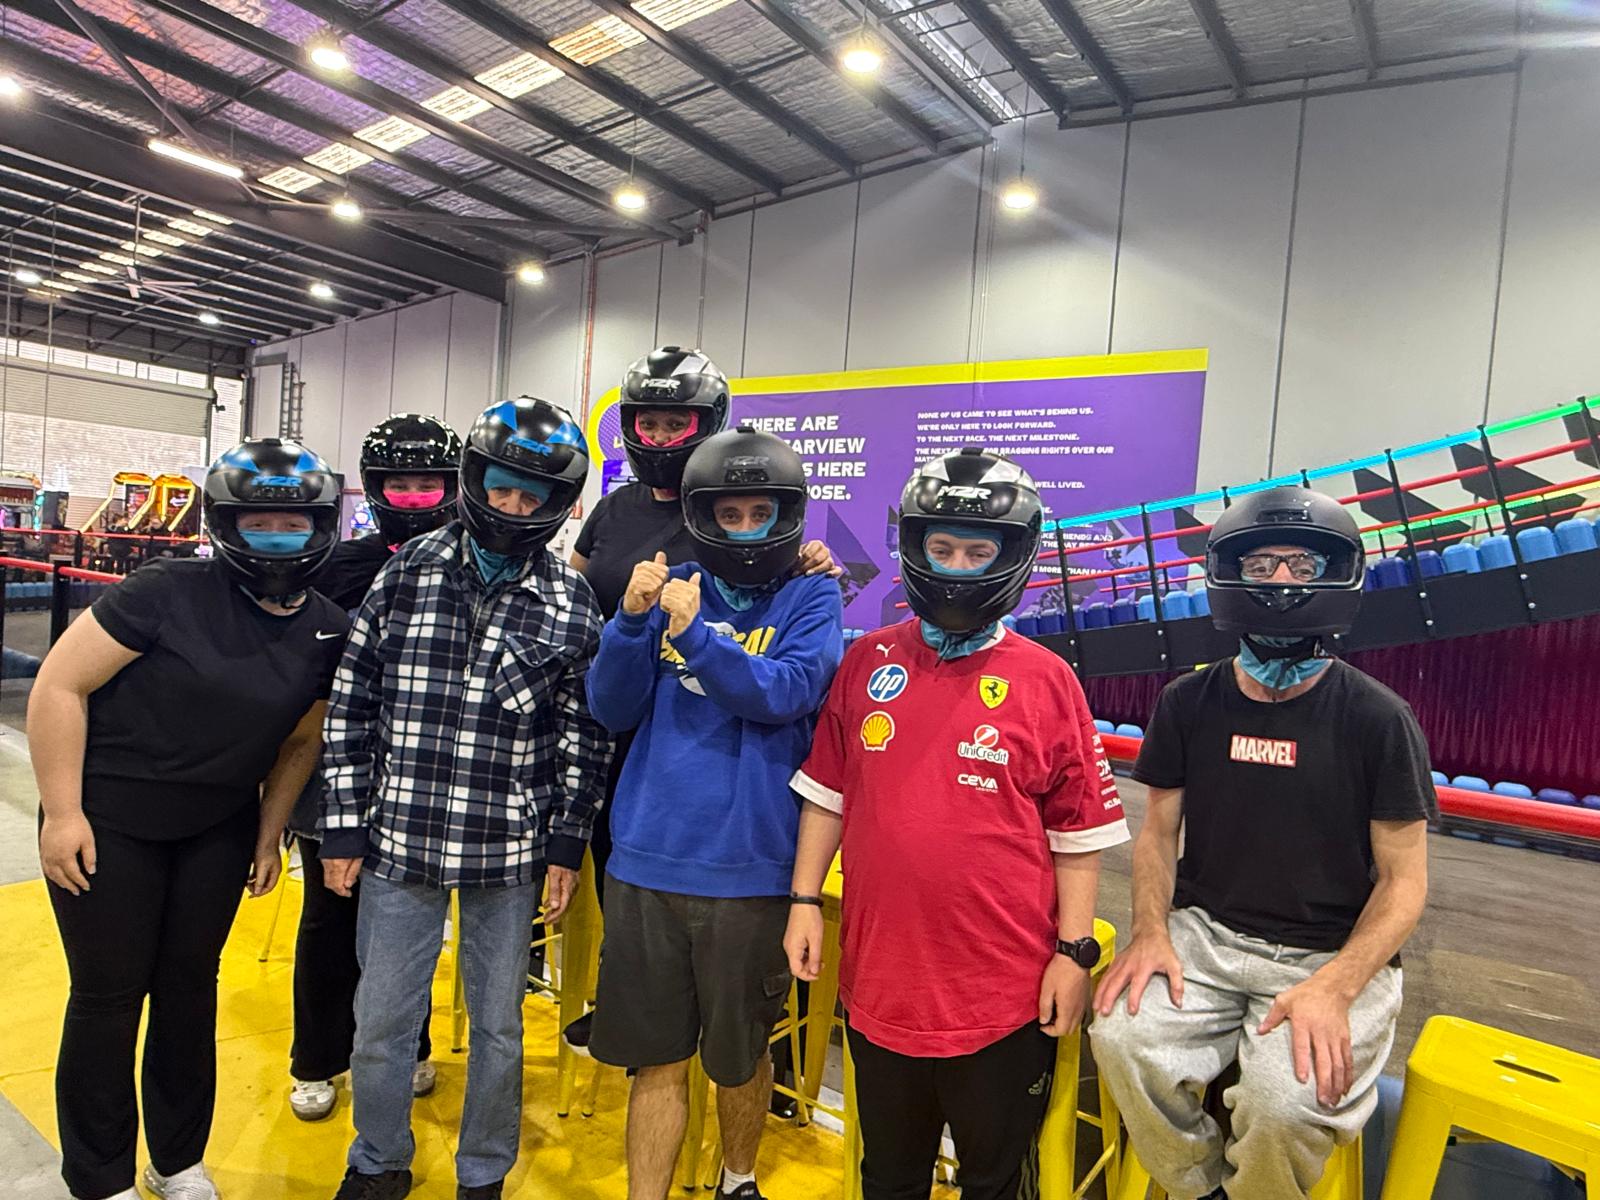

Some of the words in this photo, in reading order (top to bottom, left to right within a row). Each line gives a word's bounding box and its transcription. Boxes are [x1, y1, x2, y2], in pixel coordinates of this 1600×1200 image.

[741, 417, 797, 432] THERE
[801, 415, 839, 431] ARE
[1014, 421, 1056, 429] FORWARD.
[1029, 433, 1080, 441] MILESTONE.
[784, 437, 866, 455] ARVIEW
[1040, 446, 1070, 454] RIGHTS
[1071, 446, 1094, 454] OVER
[1096, 446, 1114, 454] OUR
[817, 462, 866, 477] HERE
[871, 666, 904, 699] hp
[959, 744, 1007, 763] UniCredit
[1231, 735, 1295, 767] MARVEL
